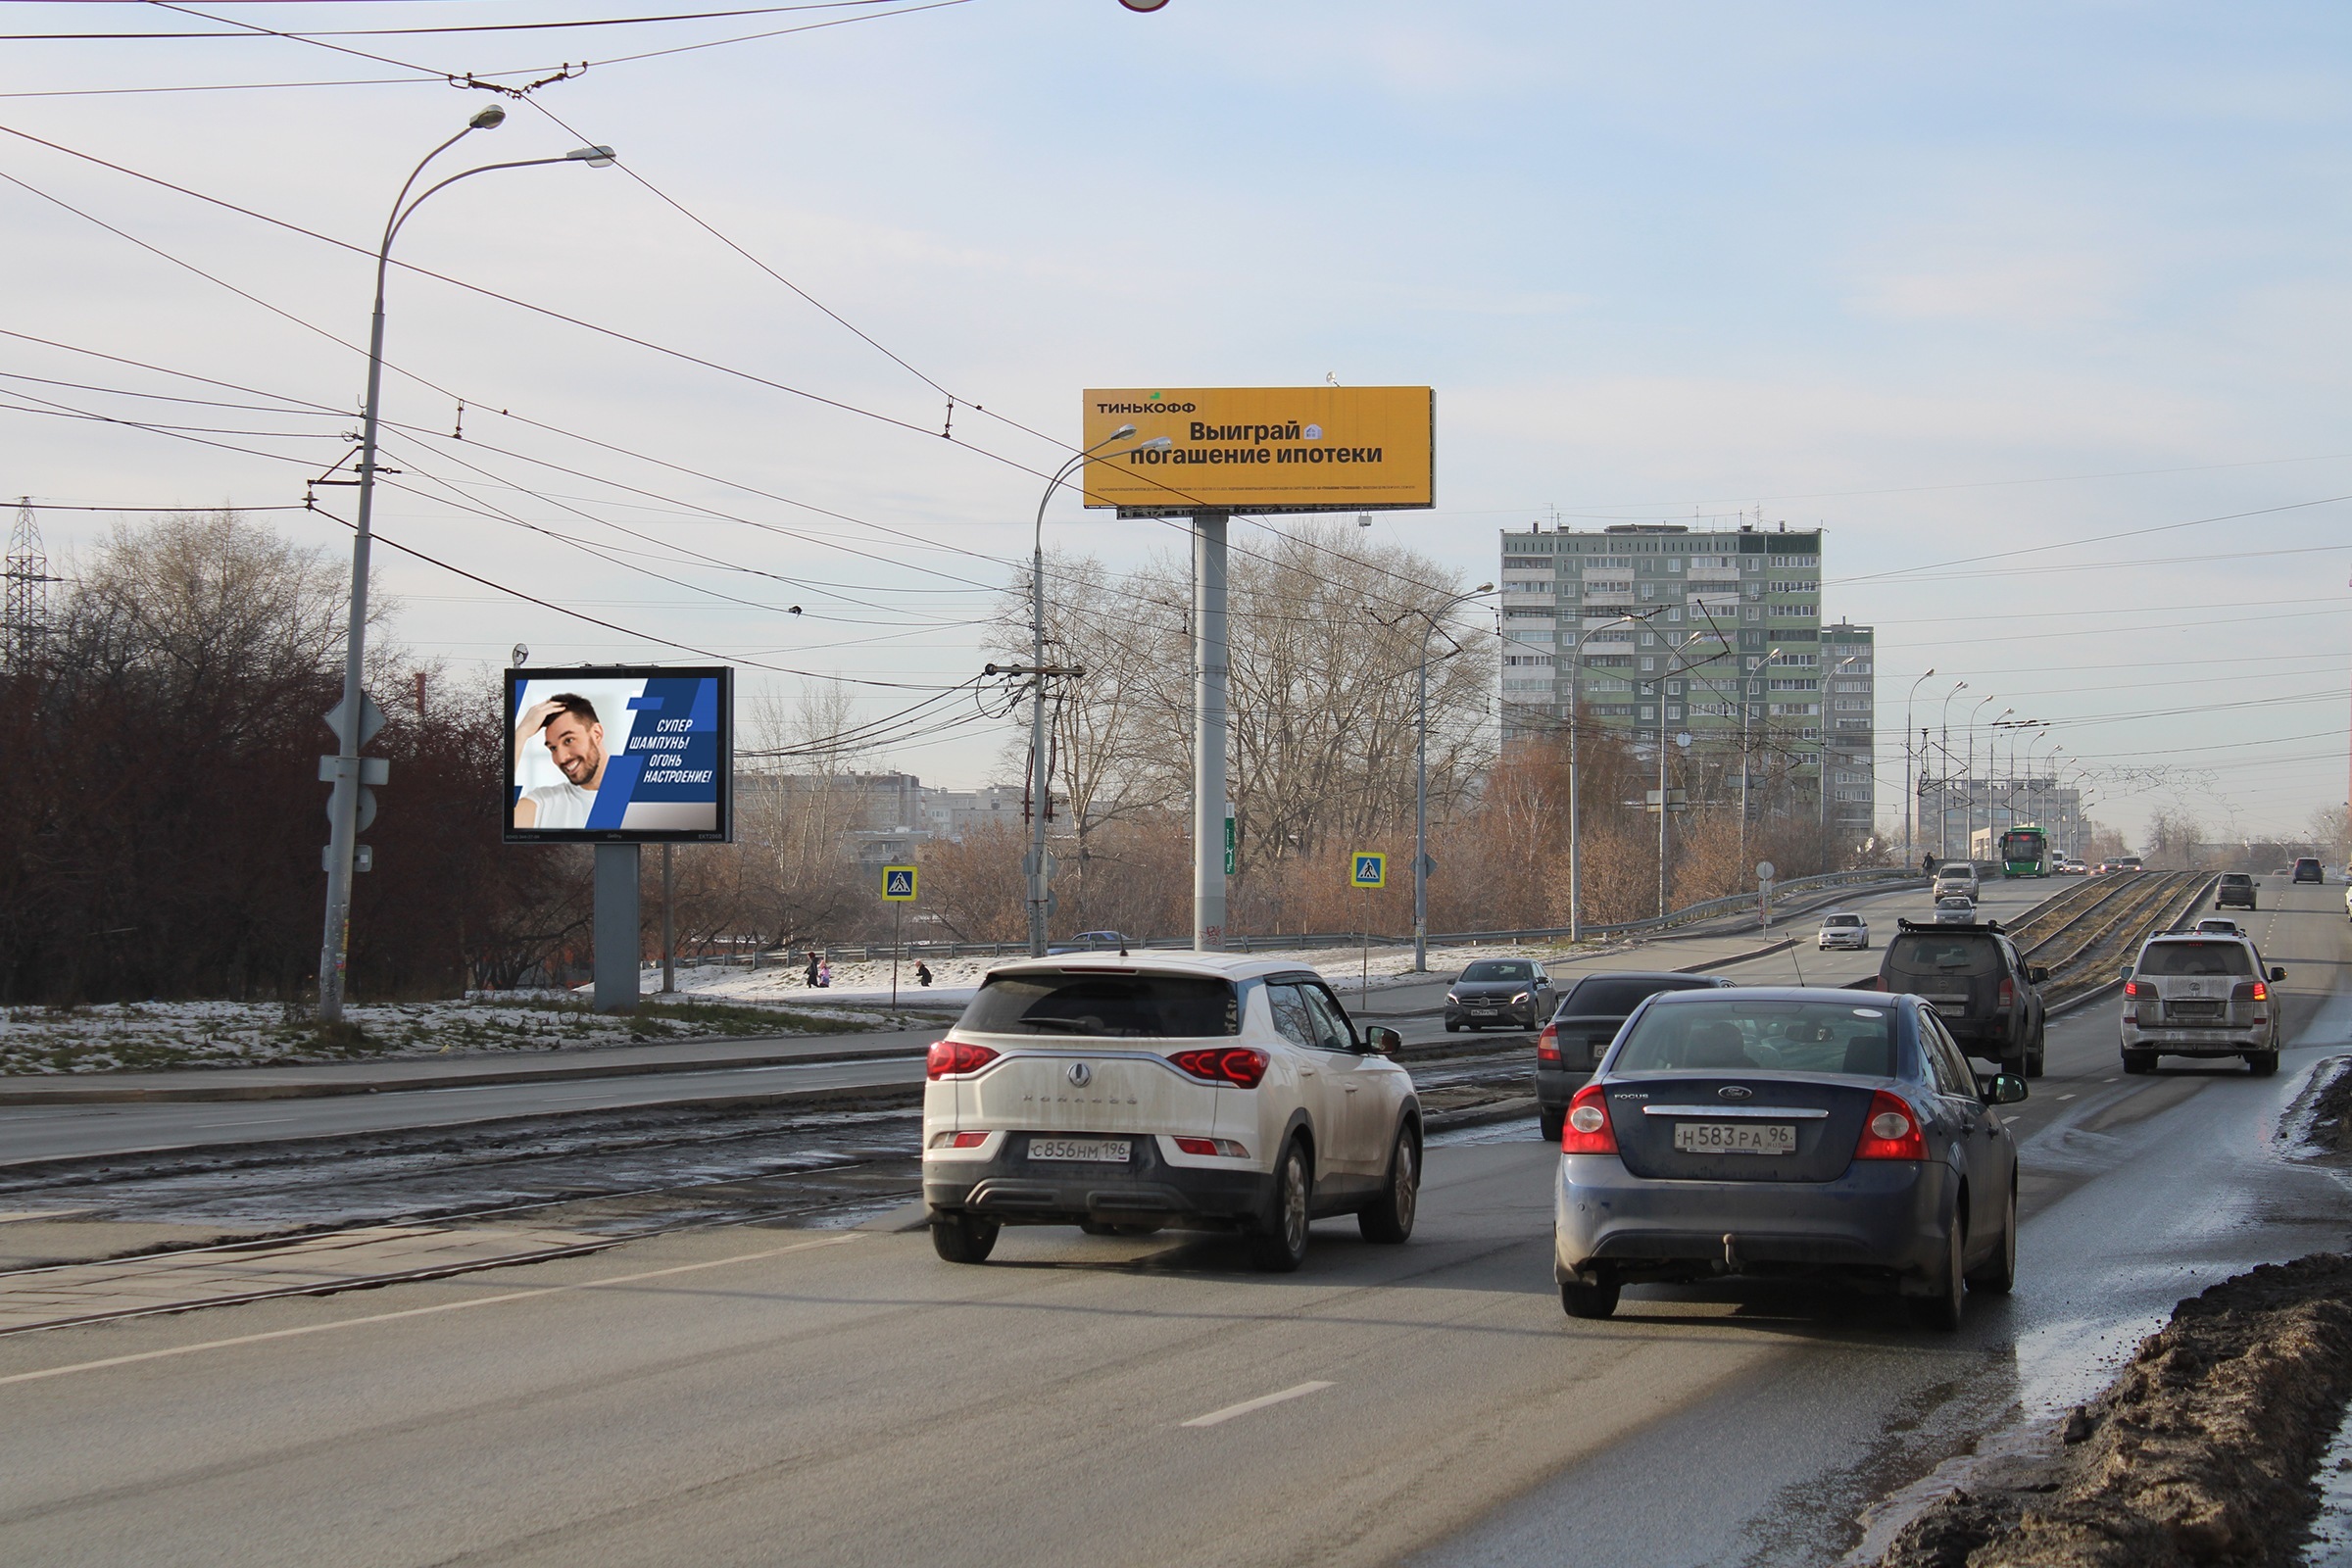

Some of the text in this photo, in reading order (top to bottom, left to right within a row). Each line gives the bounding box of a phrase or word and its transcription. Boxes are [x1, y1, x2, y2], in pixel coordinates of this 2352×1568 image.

[1097, 402, 1197, 415] ТИНЬКОФФ
[1190, 420, 1301, 445] Выиграй
[1130, 446, 1383, 465] погашение ипотеки
[657, 718, 693, 733] СУПЕР
[629, 736, 690, 750] ШАМПУНЬ!
[649, 754, 682, 767] ОГОНЬ
[643, 770, 712, 783] НАСТРОЕНИЕ!
